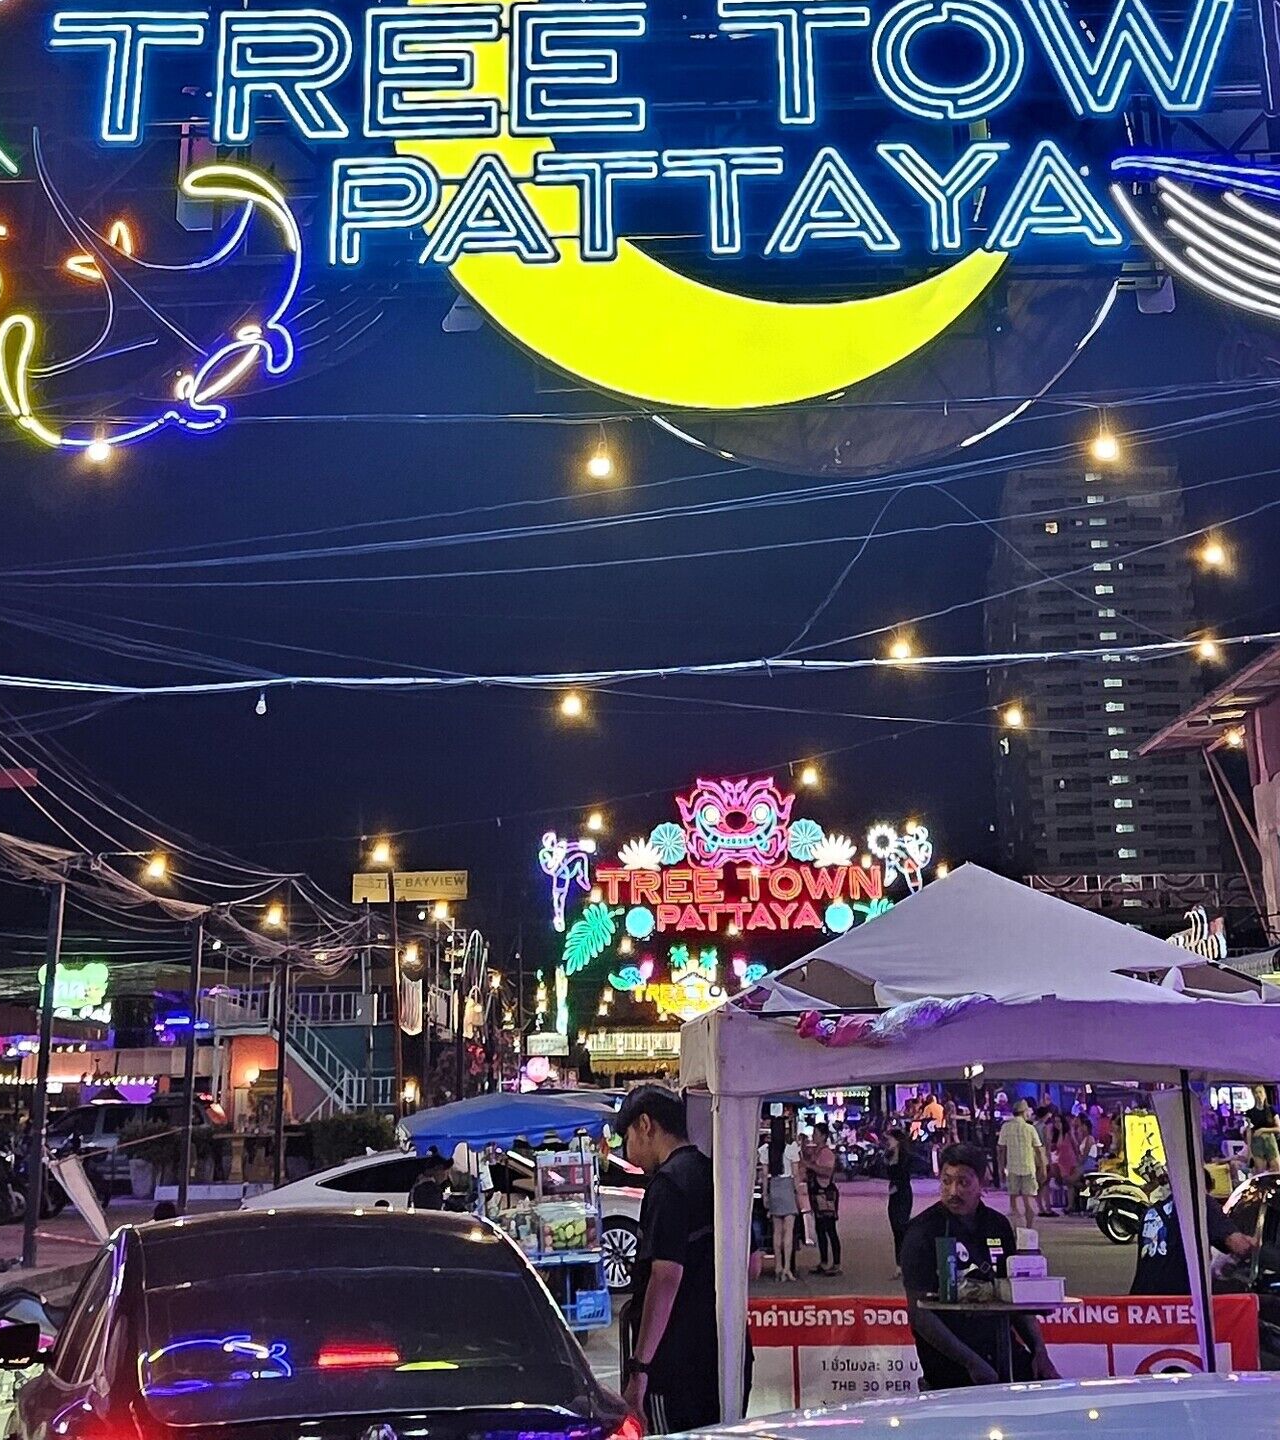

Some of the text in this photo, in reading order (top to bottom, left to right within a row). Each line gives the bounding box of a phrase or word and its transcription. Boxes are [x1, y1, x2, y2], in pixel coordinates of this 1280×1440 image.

[48, 0, 648, 143] TREE
[328, 138, 1123, 266] PATTAYA
[405, 875, 466, 887] BAYVIEW
[595, 864, 884, 905] TREE TOWN
[656, 902, 824, 932] PATTAYA
[863, 1308, 909, 1326] จอด
[887, 1360, 903, 1372] 30
[832, 1380, 912, 1392] THB 30 PER
